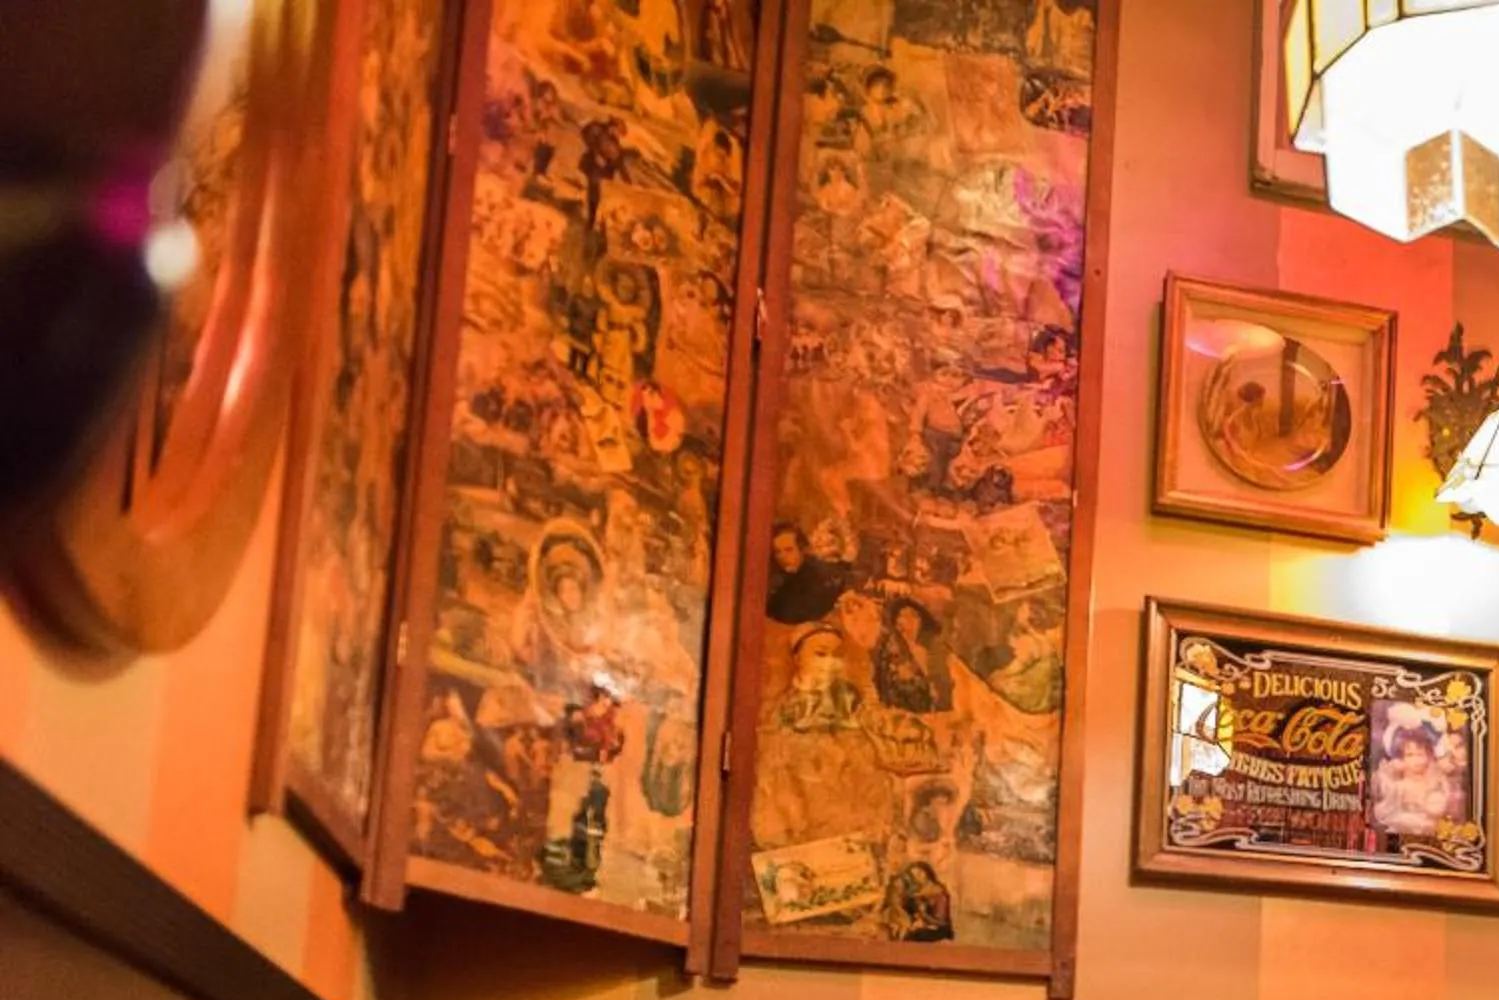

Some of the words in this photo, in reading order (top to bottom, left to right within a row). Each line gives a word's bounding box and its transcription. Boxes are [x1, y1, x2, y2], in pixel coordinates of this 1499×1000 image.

[1252, 671, 1363, 711] DELICIOUS
[1286, 757, 1364, 790] FATIGUE
[1323, 788, 1363, 812] DRINK
